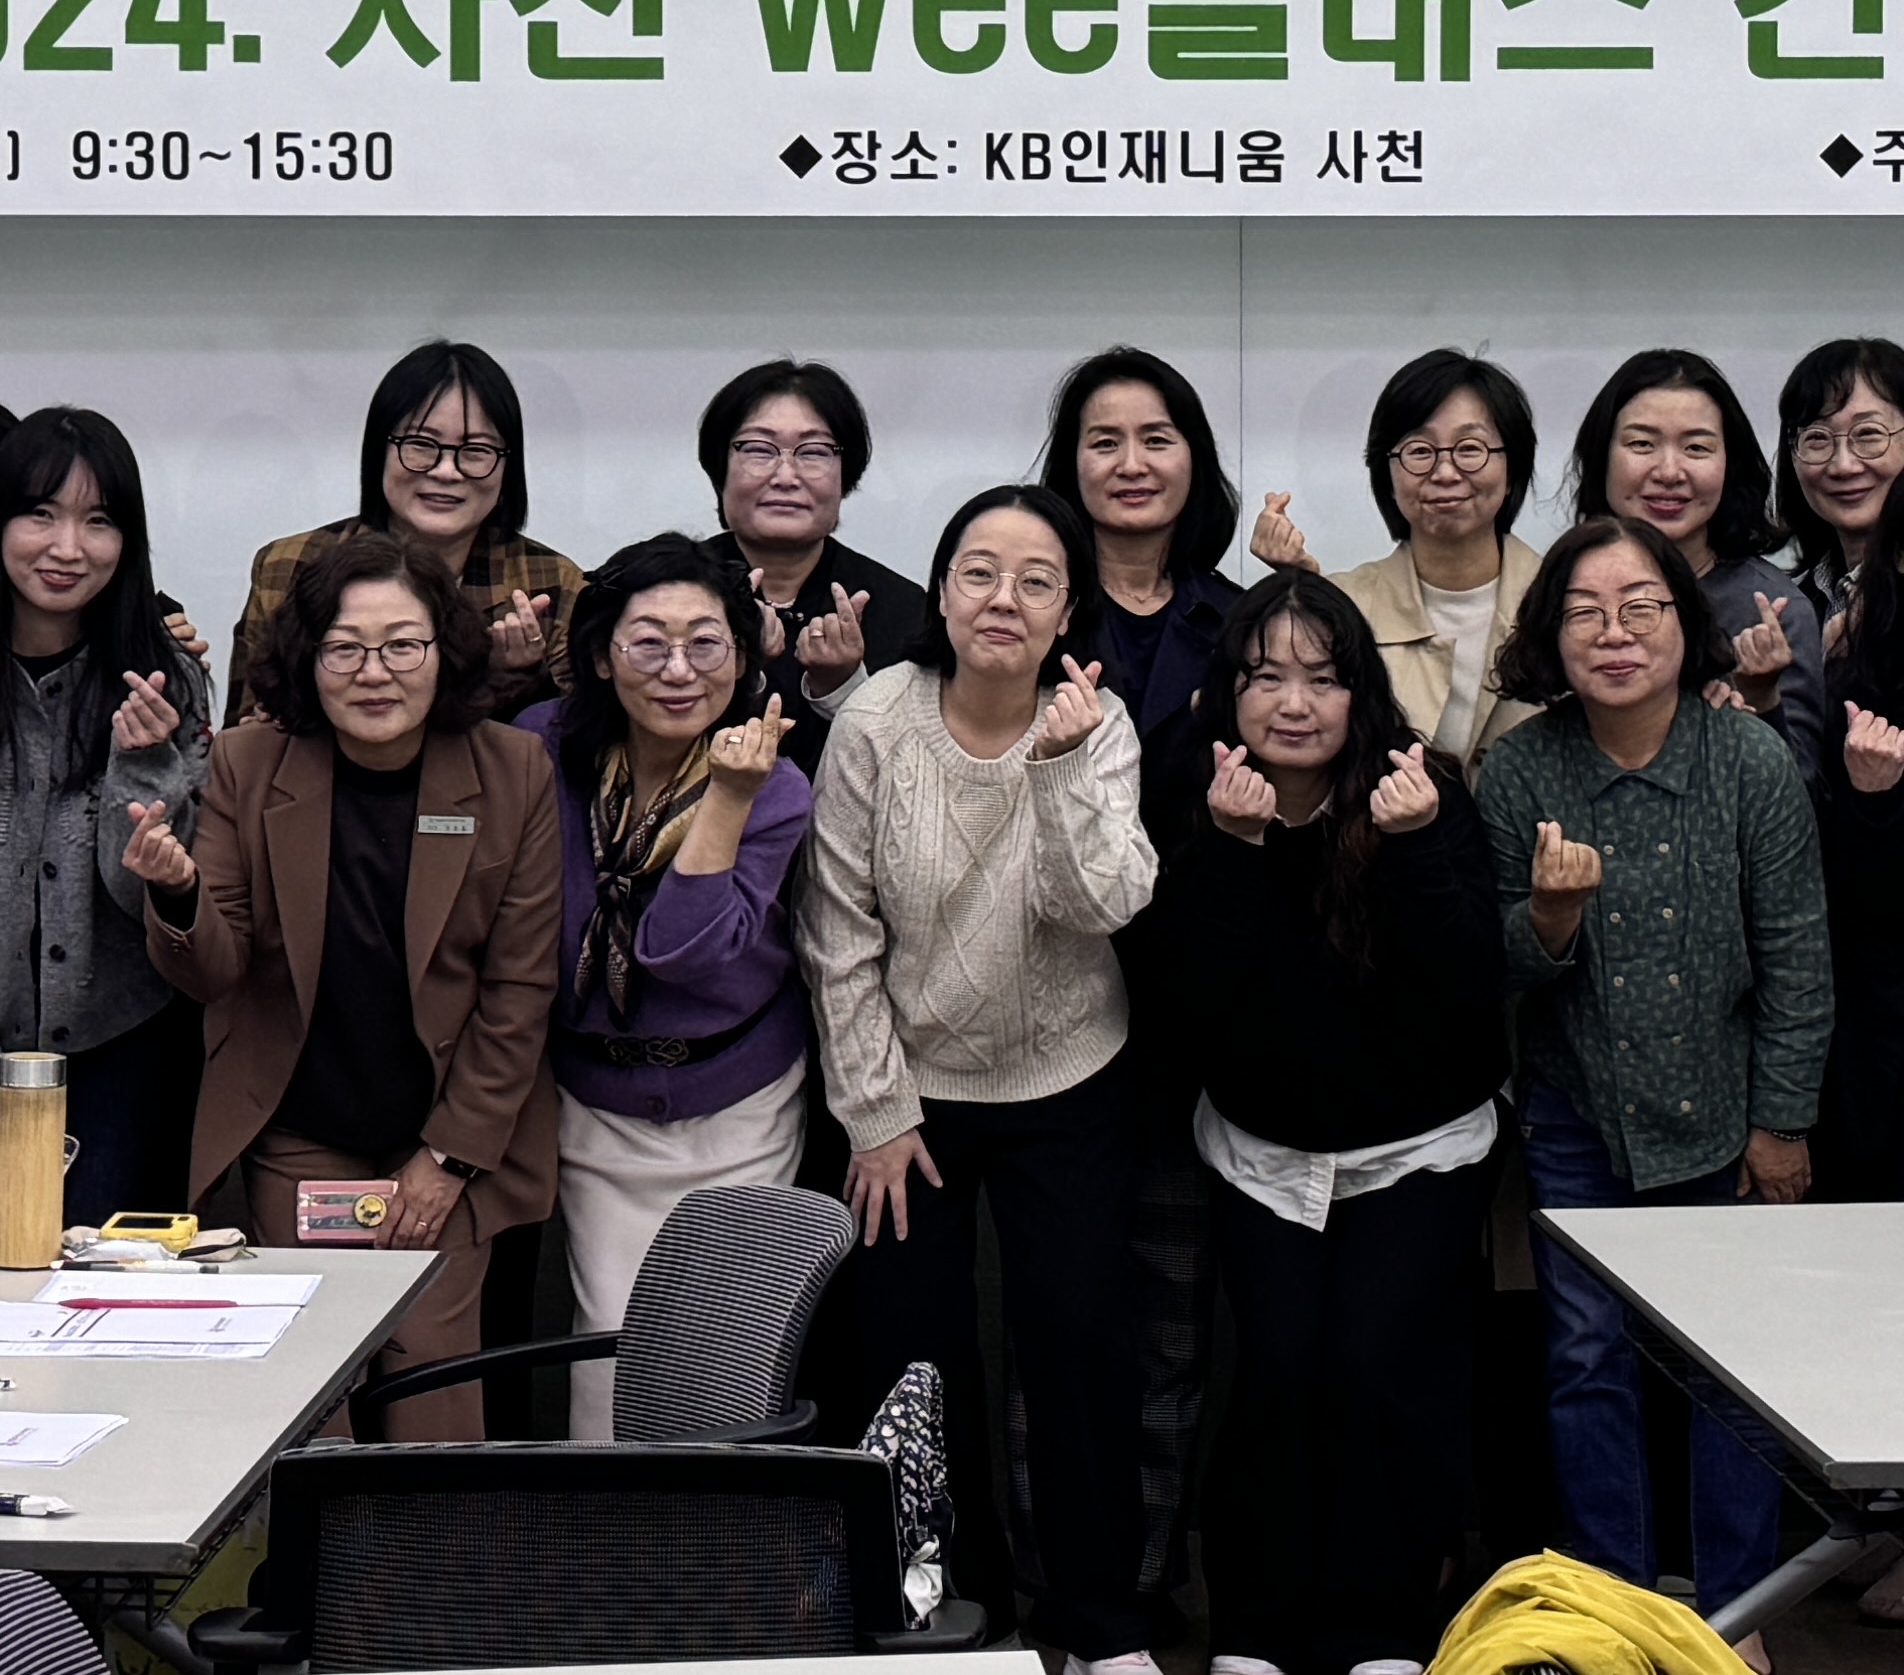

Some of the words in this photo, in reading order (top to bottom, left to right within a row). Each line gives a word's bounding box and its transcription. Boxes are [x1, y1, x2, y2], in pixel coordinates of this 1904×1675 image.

[72, 130, 392, 181] 9:30~15:30
[831, 130, 957, 185] 장소:
[985, 130, 1285, 184] KB인재니움
[1316, 130, 1423, 184] 사천
